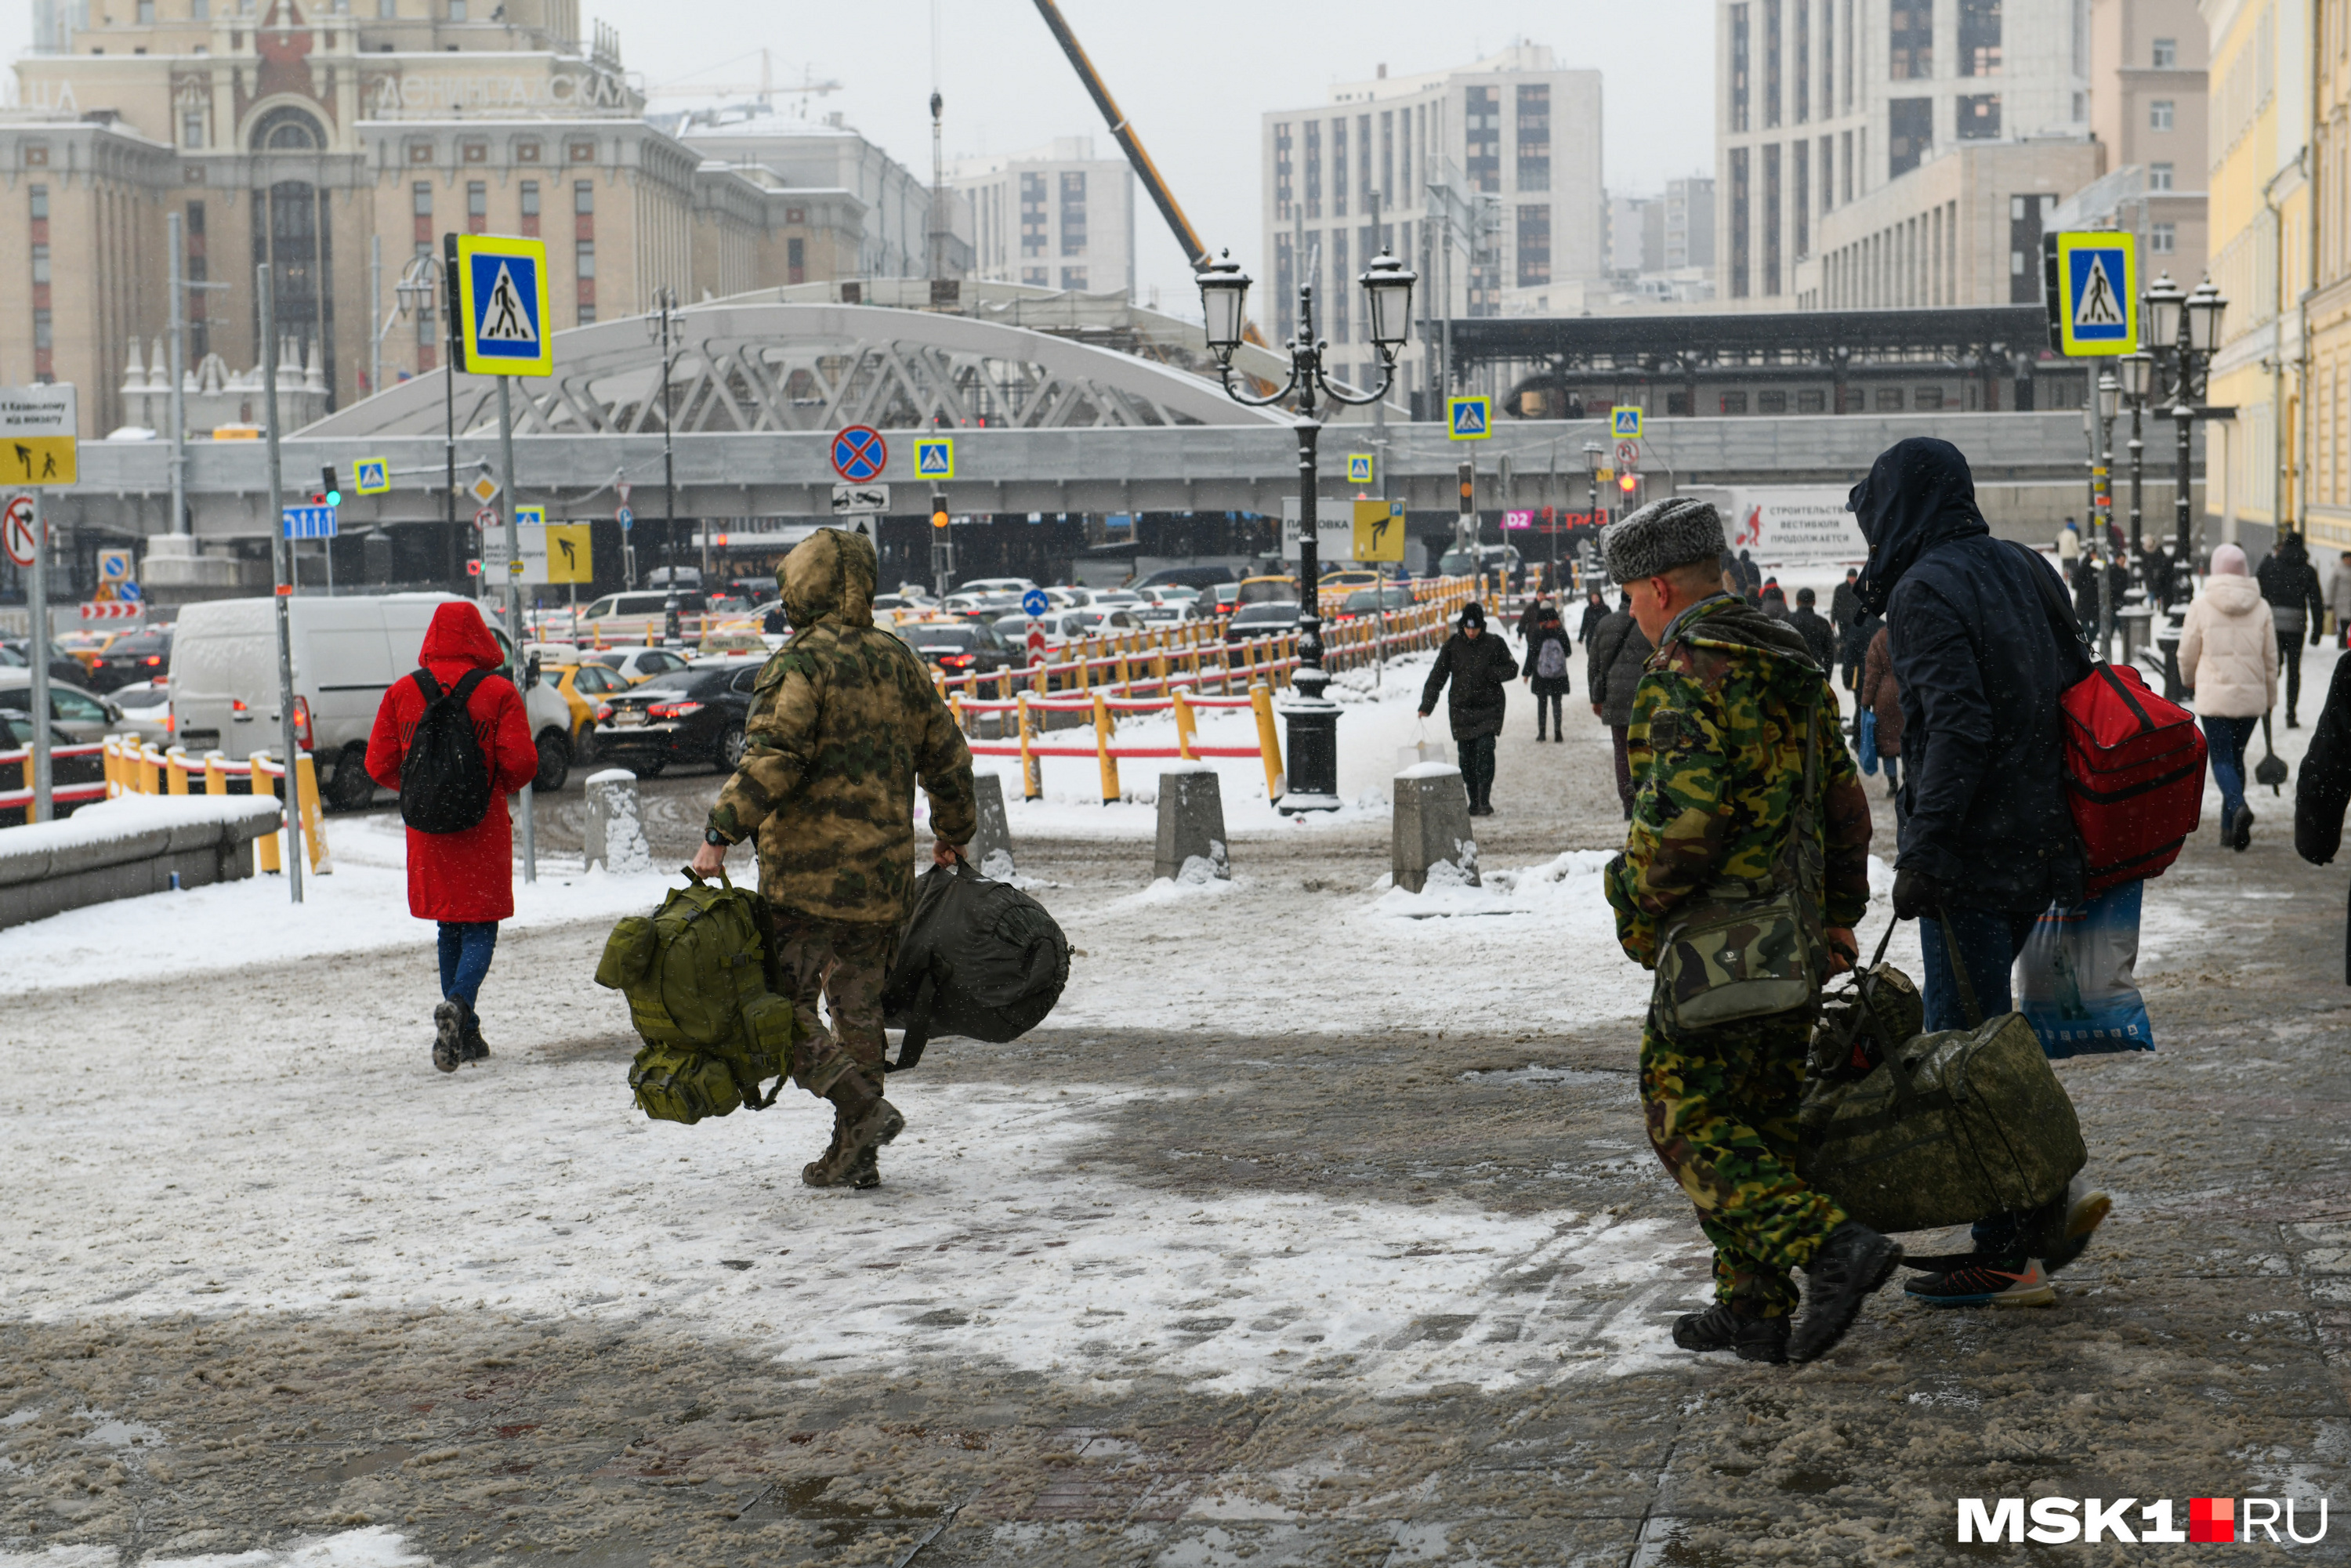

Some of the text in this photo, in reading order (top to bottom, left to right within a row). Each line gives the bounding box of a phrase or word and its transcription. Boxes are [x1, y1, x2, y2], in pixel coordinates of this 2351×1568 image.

[380, 74, 629, 108] ЛЕНИНГРАДСКАЯ
[1286, 519, 1349, 530] ПАОВКА
[1507, 512, 1528, 527] D2
[1780, 520, 1839, 529] ВЕСТИБЮЛЯ
[1770, 534, 1849, 544] ПРОДОЛЖАЕТСЯ
